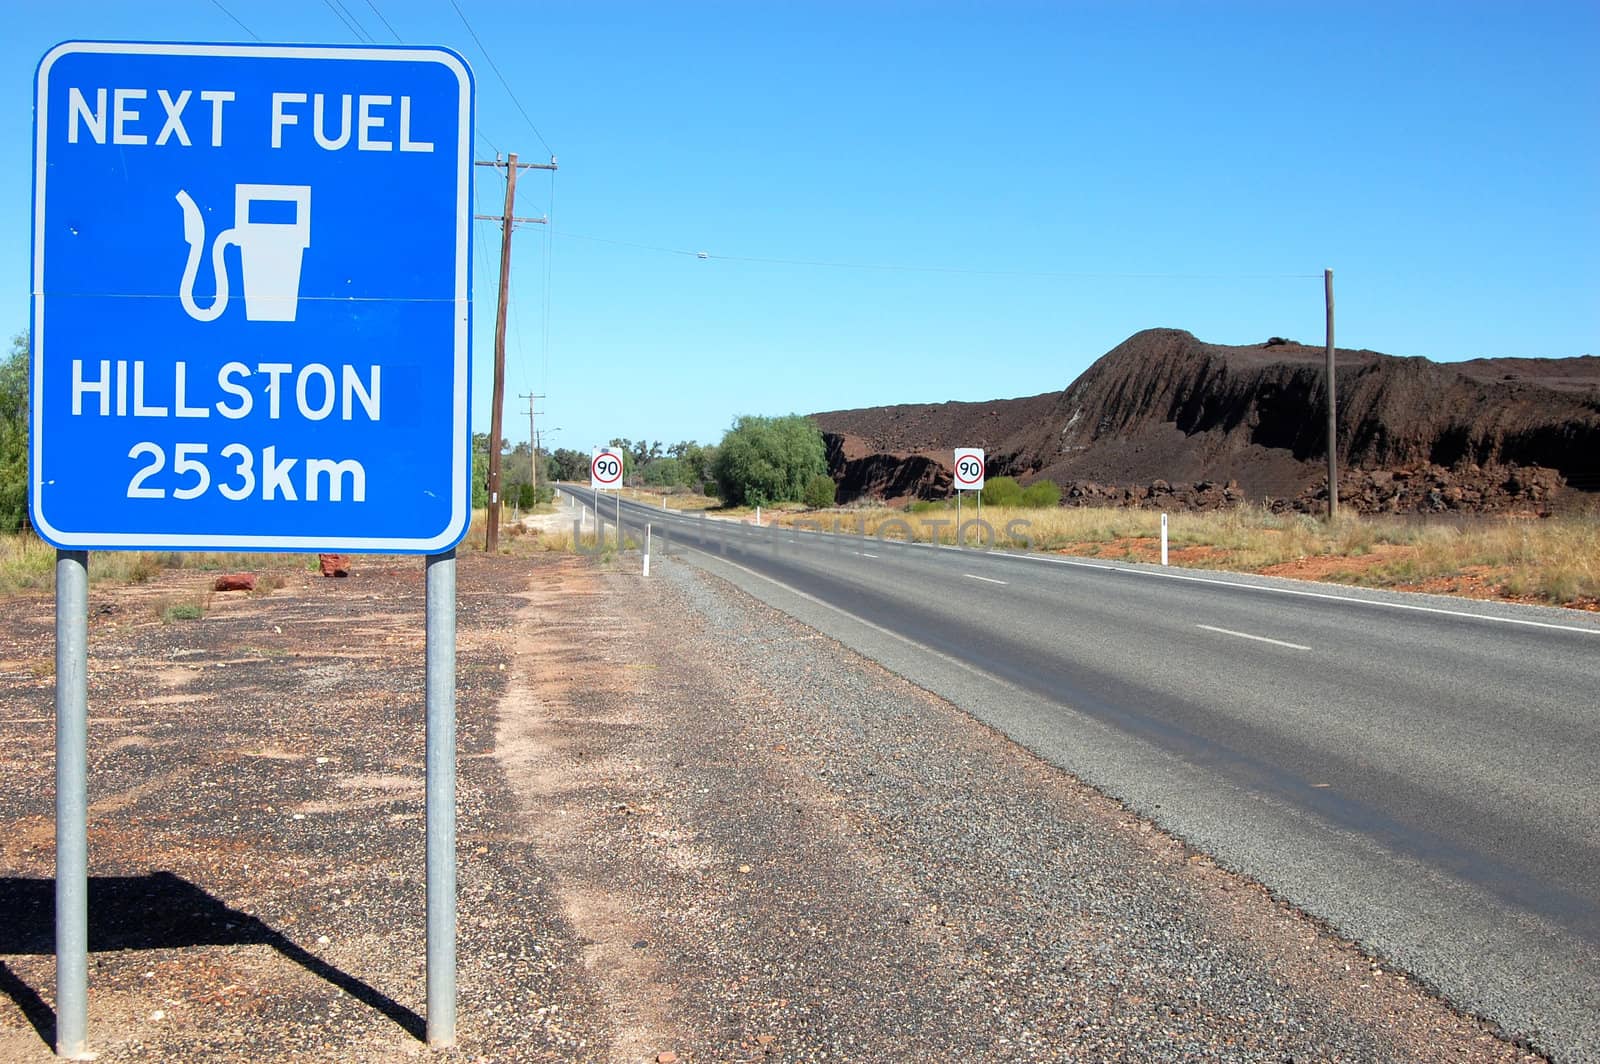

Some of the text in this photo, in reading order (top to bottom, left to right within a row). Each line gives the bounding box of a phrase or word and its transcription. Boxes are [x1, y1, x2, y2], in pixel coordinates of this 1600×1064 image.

[68, 87, 434, 153] NEXT FUEL
[71, 359, 381, 421] HILLSTON
[126, 441, 366, 502] 253km
[597, 461, 618, 476] 90
[960, 462, 979, 477] 90
